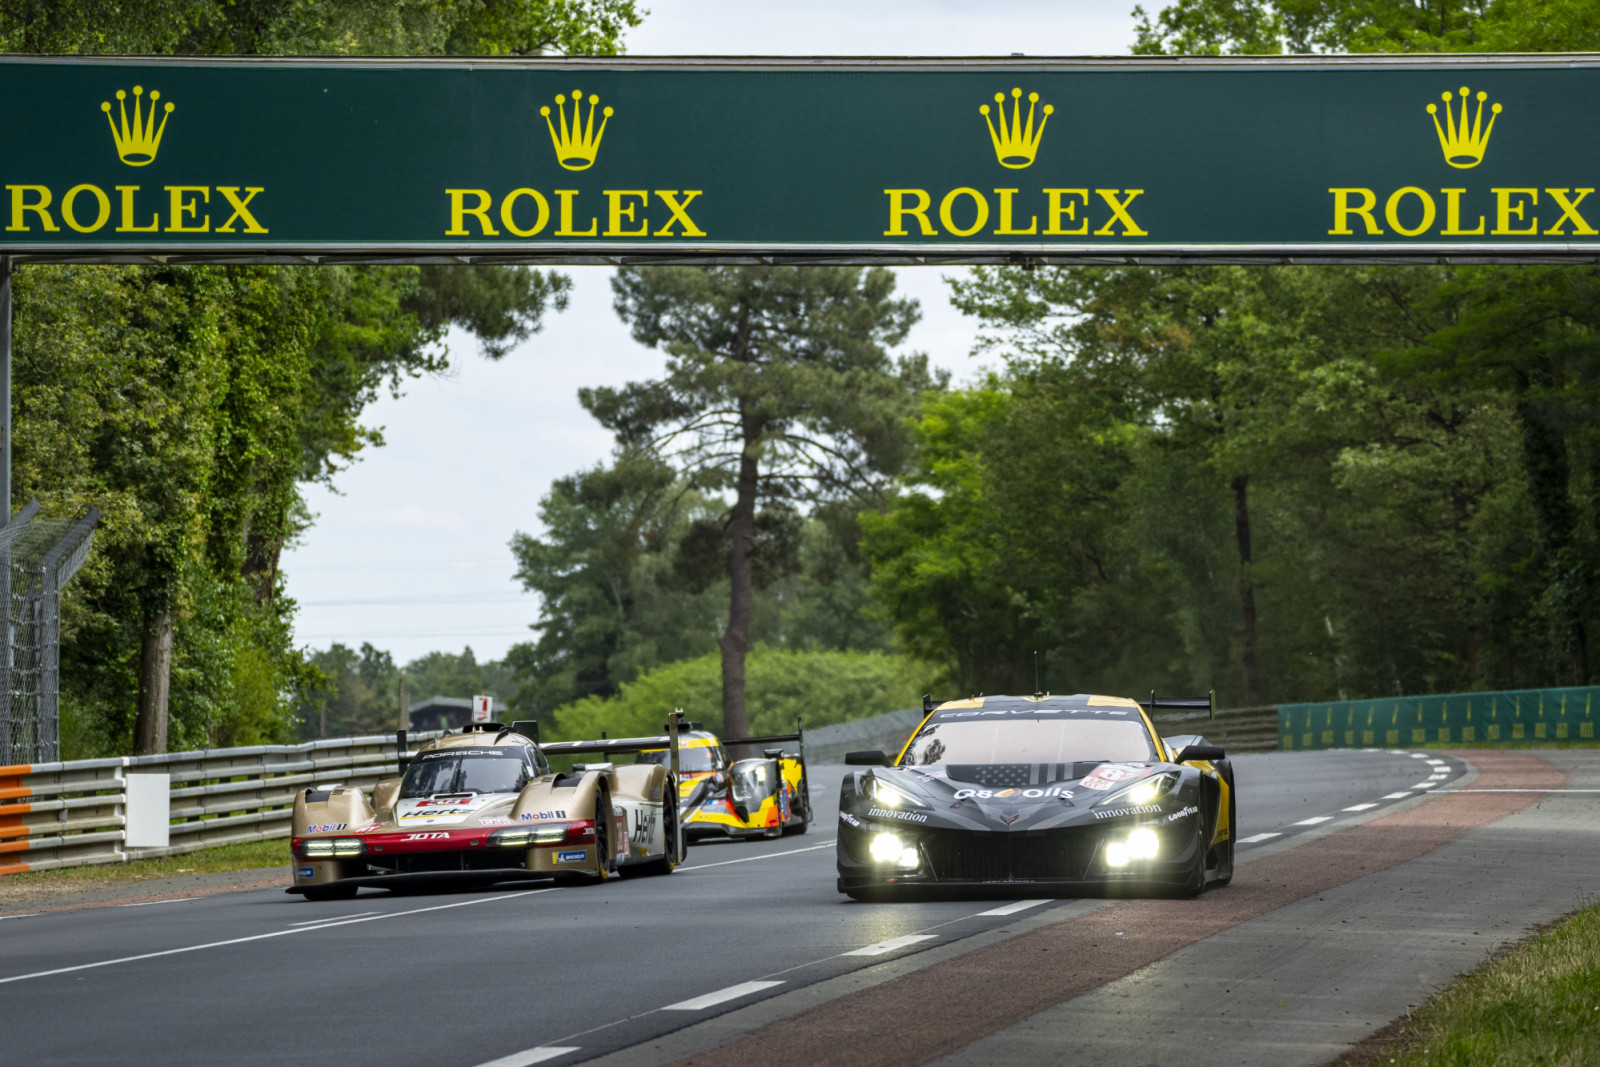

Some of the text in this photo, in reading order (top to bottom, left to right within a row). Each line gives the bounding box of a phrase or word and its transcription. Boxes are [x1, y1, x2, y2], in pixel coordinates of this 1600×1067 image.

[5, 183, 268, 234] ROLEX
[444, 187, 706, 237] ROLEX
[883, 187, 1148, 237] ROLEX
[1328, 186, 1599, 236] ROLEX
[939, 709, 1129, 718] CORVETTE
[422, 750, 504, 760] PORSCHE
[953, 788, 1075, 800] Q8 Oils
[402, 808, 476, 818] Hertz
[521, 811, 554, 821] Mobil
[867, 804, 928, 823] innovation
[1092, 803, 1162, 819] innovation
[306, 823, 336, 834] Mobil
[632, 808, 656, 845] Hertz
[400, 831, 450, 842] JOTA
